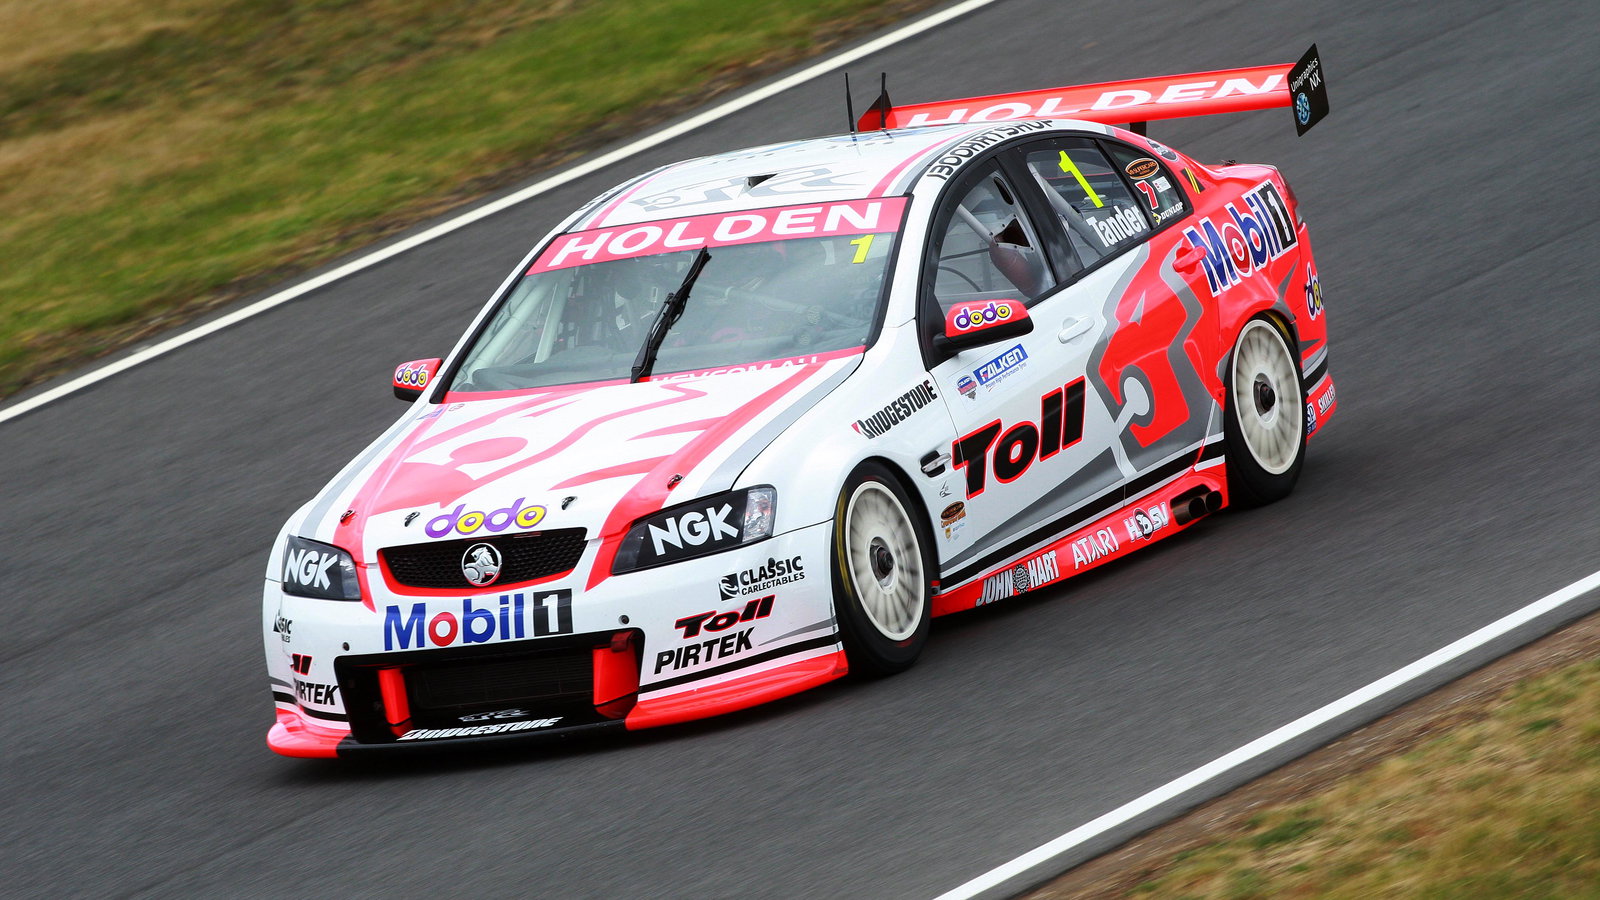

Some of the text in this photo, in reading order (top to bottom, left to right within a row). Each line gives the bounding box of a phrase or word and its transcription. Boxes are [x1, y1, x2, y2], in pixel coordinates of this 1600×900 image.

[910, 74, 1284, 125] HOLDEN
[1310, 69, 1321, 91] NX
[1059, 150, 1104, 208] 1
[1086, 205, 1147, 248] Tander
[1161, 202, 1183, 219] DUNLOP
[547, 200, 883, 268] HOLDEN
[849, 234, 874, 264] 1
[1182, 182, 1297, 297] Mobil 1
[953, 302, 1013, 331] dodo
[396, 363, 428, 386] dodo
[979, 348, 1024, 381] FALKEN
[853, 379, 937, 439] BRIDGESTONE
[952, 376, 1087, 499] Toll
[425, 497, 548, 539] dodo
[647, 503, 742, 556] NGK
[1071, 527, 1120, 569] ATARI
[284, 549, 338, 590] NGK
[740, 556, 803, 585] CLASSIC
[741, 572, 805, 596] CARLECTABLES
[976, 550, 1059, 606] JOHN HART
[383, 591, 568, 652] Mobil 1
[674, 595, 776, 639] Toll
[654, 628, 755, 675] PIRTEK
[397, 717, 563, 741] BRIDGESTONE
